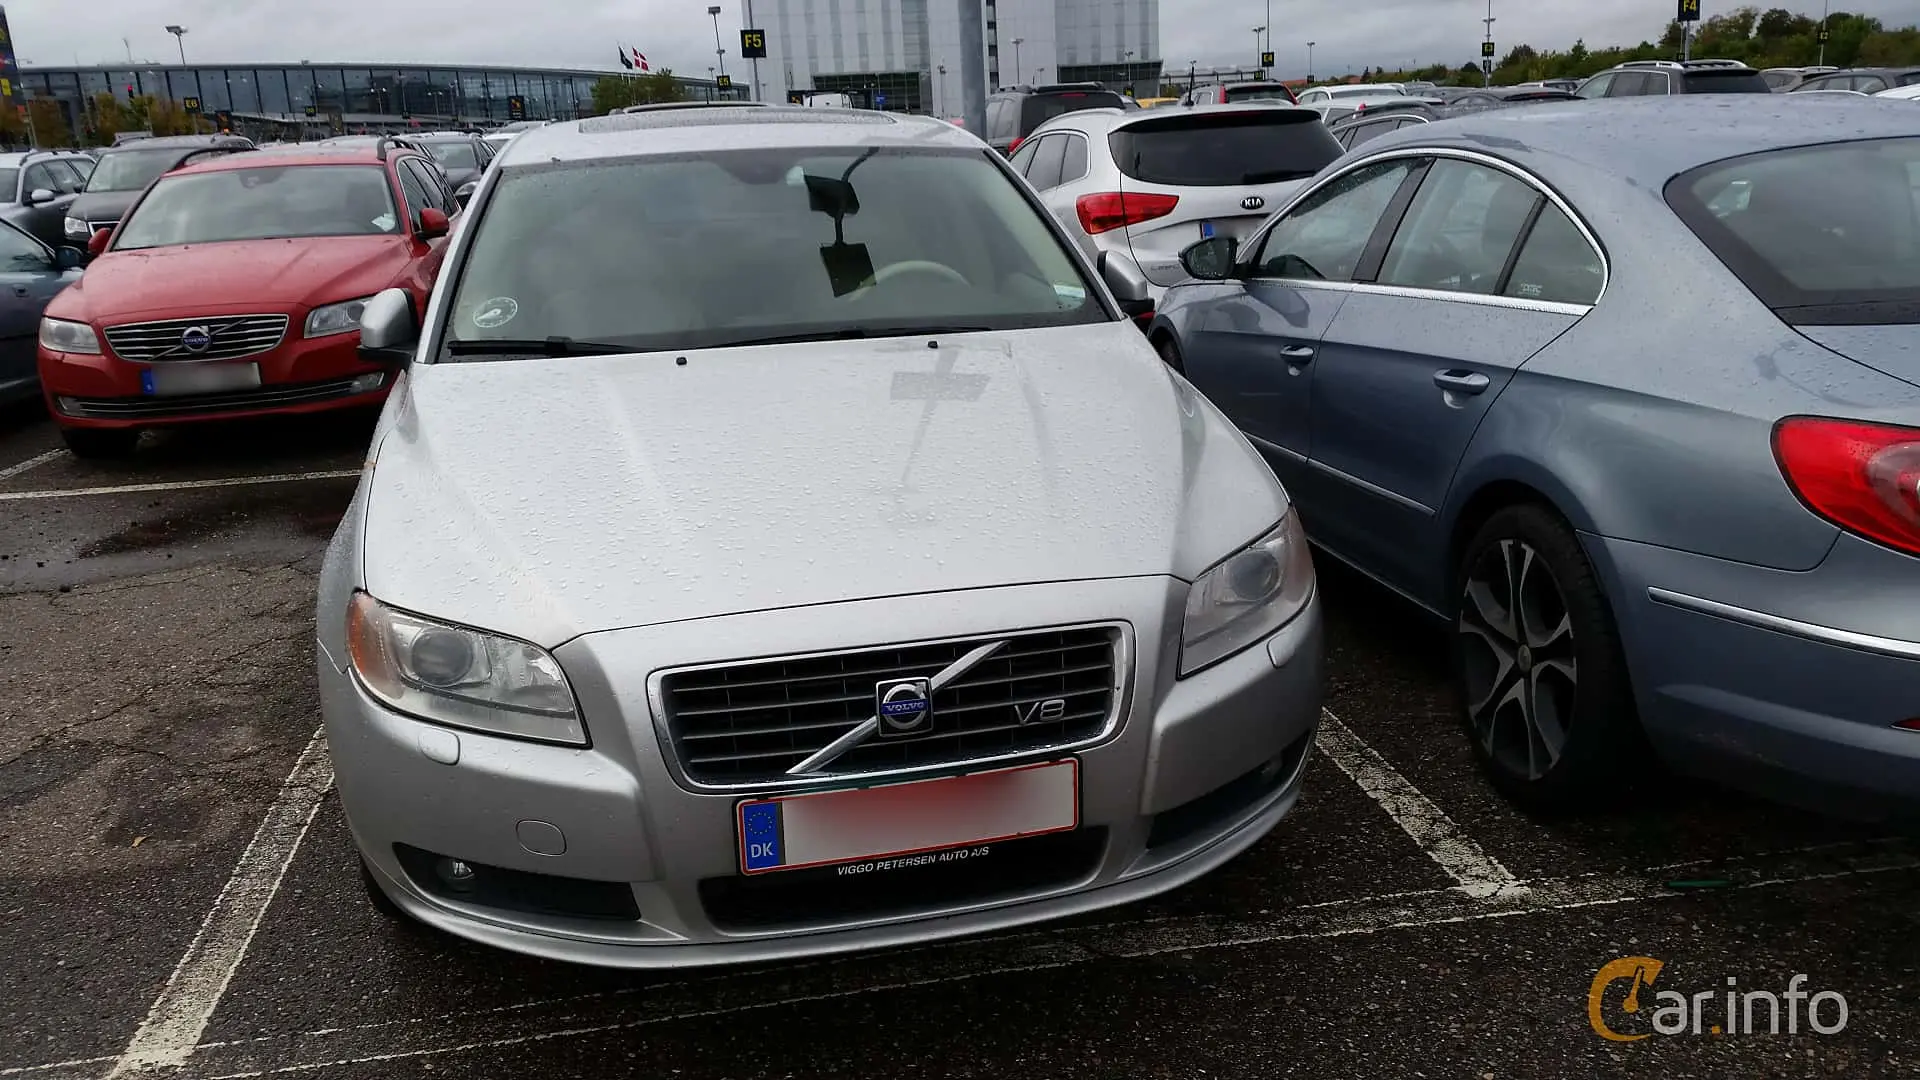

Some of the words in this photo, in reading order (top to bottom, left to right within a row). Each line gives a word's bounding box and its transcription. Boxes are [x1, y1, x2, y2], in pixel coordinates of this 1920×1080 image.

[1683, 0, 1697, 12] F4
[744, 34, 762, 48] F5
[885, 701, 925, 712] VOLVO
[1014, 699, 1065, 727] V8
[750, 842, 774, 858] DK
[838, 863, 873, 876] VIGGO
[876, 854, 937, 871] PETERSEN
[939, 849, 969, 862] AUTO
[971, 846, 990, 857] A/S
